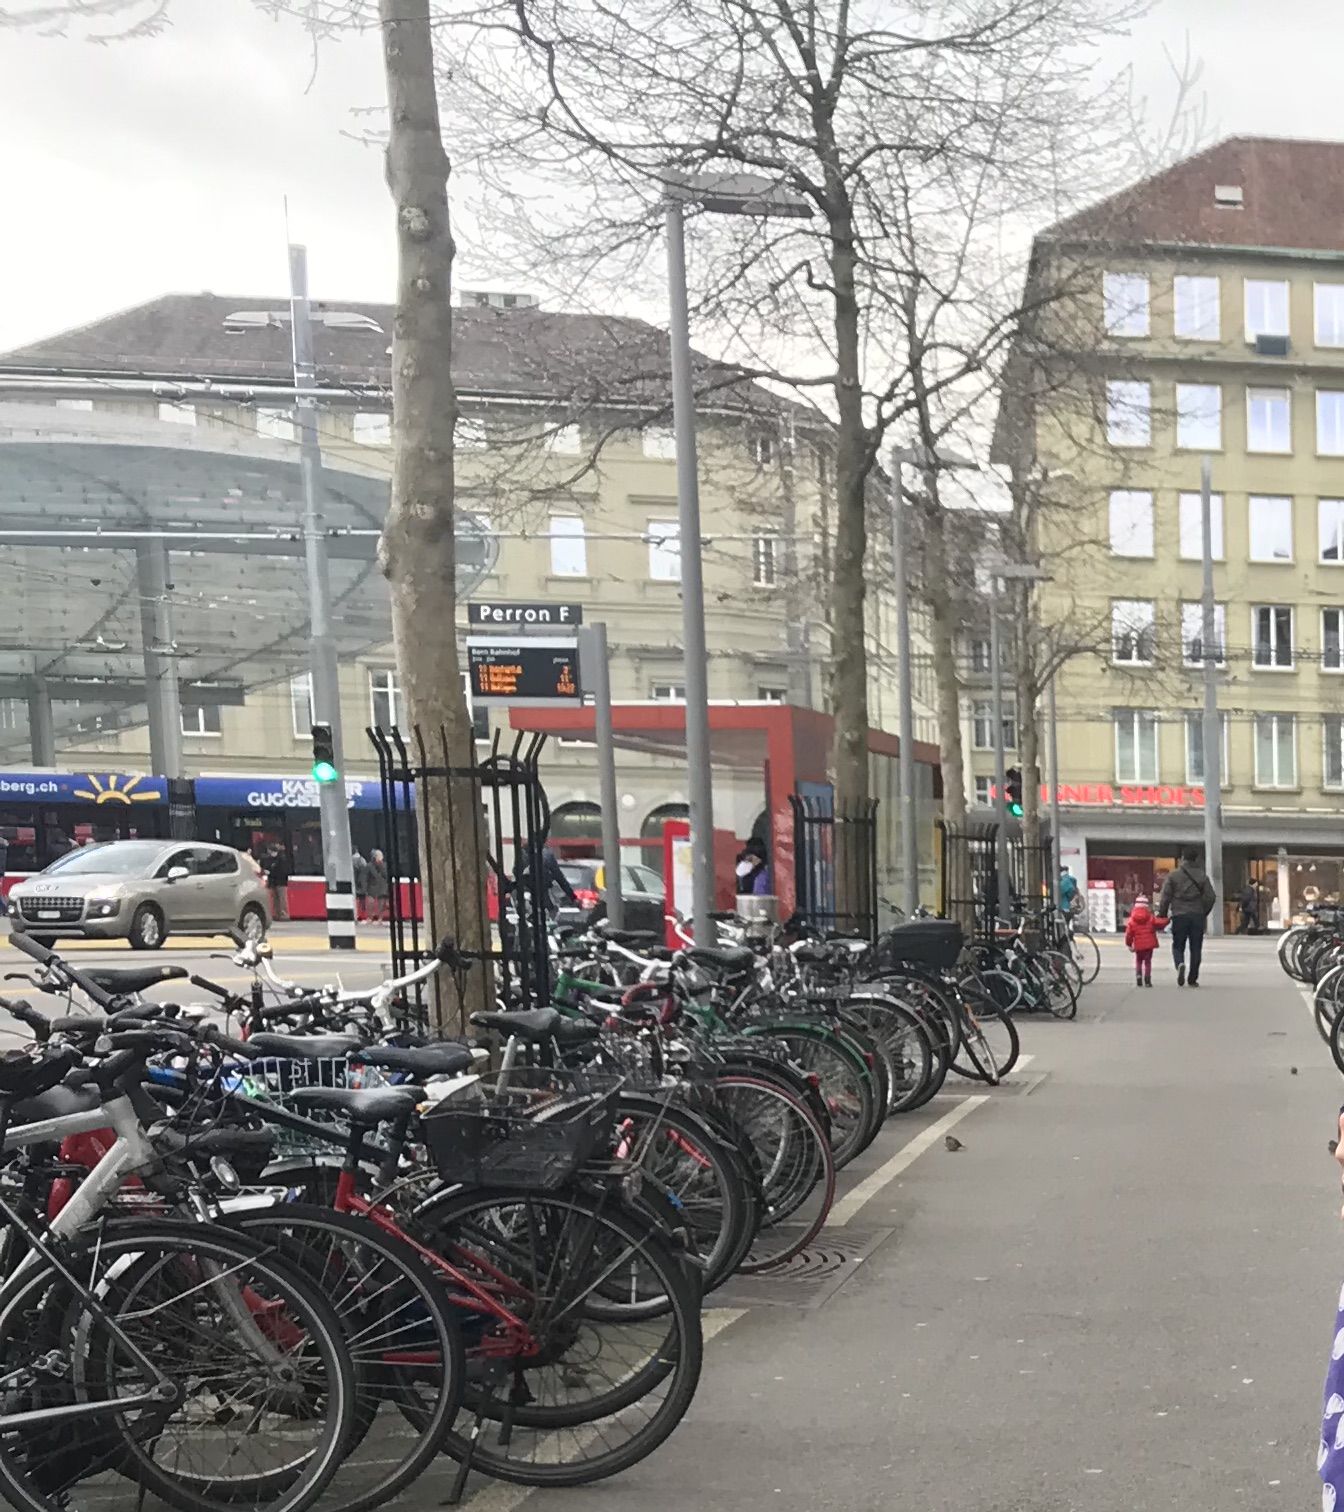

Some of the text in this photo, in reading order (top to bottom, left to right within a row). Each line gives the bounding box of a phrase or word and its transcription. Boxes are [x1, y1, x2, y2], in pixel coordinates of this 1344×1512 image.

[480, 605, 570, 622] Perron F
[1121, 786, 1206, 805] SHOES
